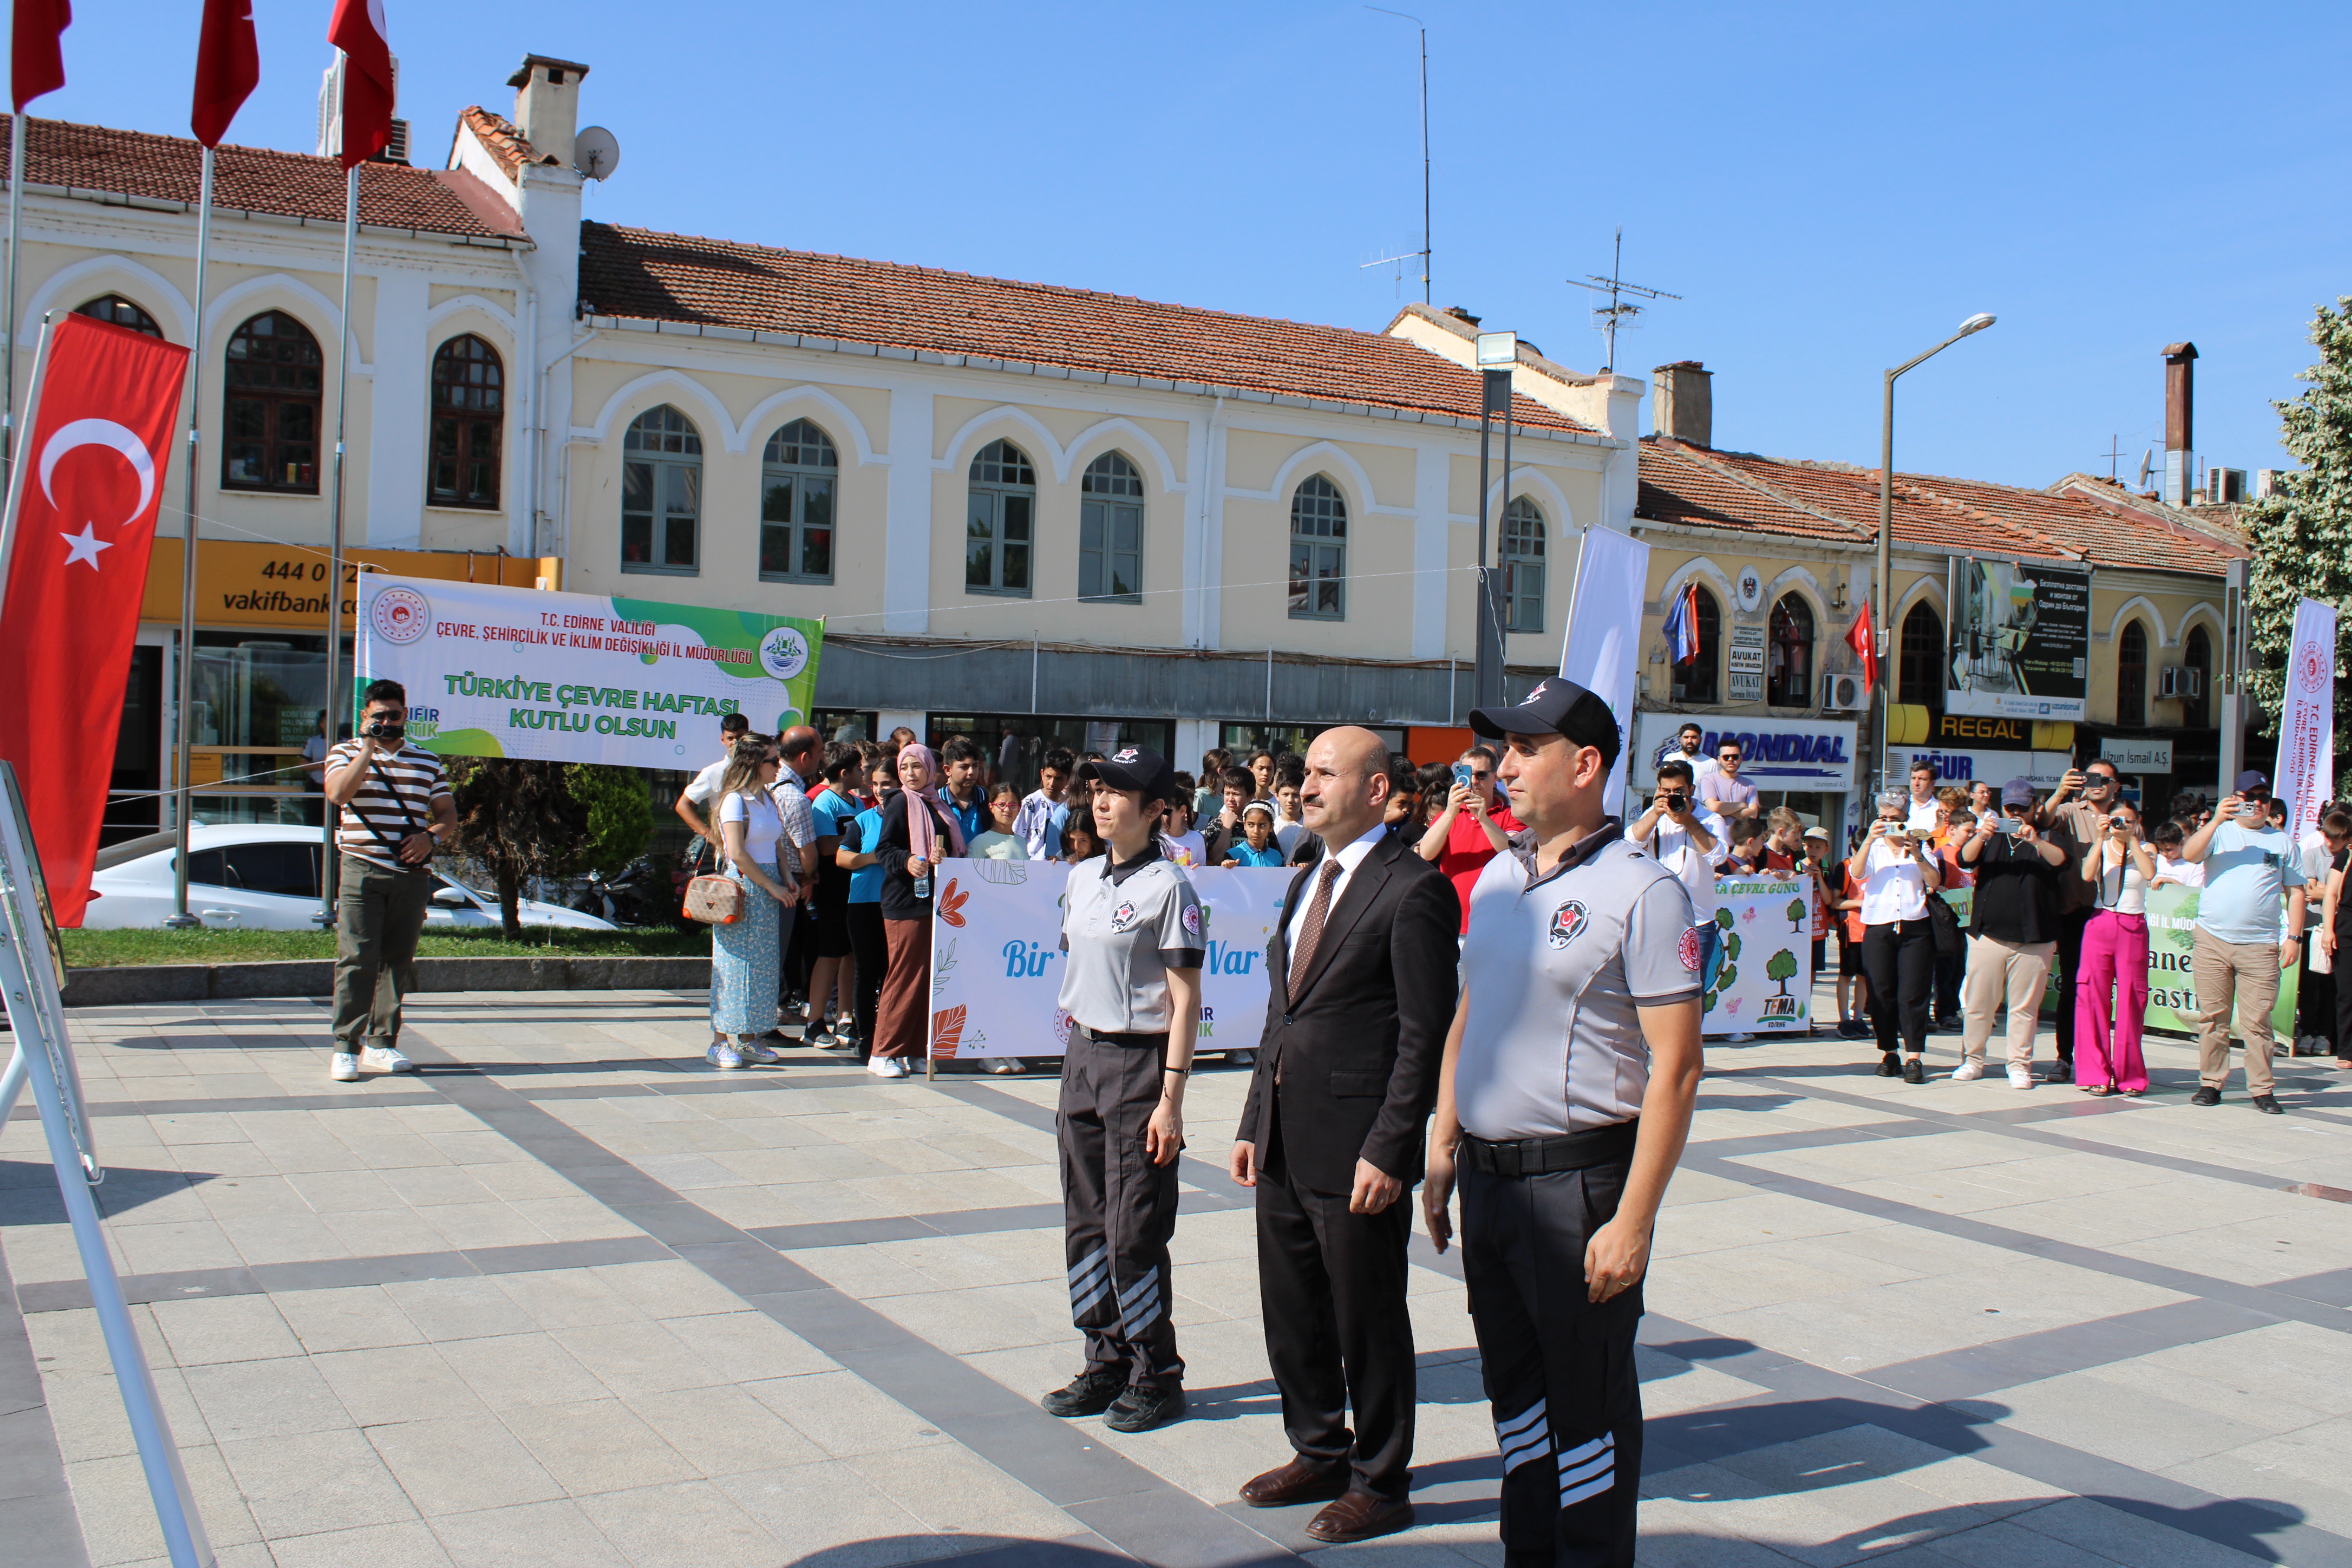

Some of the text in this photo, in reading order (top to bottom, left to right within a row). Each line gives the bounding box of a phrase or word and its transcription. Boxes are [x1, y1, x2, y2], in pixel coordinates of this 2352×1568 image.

[262, 561, 305, 580] 444
[311, 563, 326, 582] 0
[541, 612, 656, 636] T.C. EDİRNE VALİLİĞİ
[436, 621, 753, 665] ÇEVRE, ŞEHİRCİLİK VE İKLİM DEĞİŞİKLİĞİ İL MÜDÜRLÜĞÜ
[1732, 651, 1762, 661] AVUKAT
[1730, 675, 1760, 688] AVUKAT
[444, 670, 740, 718] TÜRKİYE ÇEVRE HAFTASI
[409, 707, 440, 722] IFIR
[509, 708, 677, 740] KUTLU OLSUN
[1941, 716, 2023, 740] REGAL
[1701, 731, 1849, 764] MONDIAL
[2103, 749, 2169, 767] Uzun İsmail A.Ş.
[2296, 736, 2306, 788] ŞEHİRCİLİK
[2305, 704, 2319, 822] T.C. EDİRNE VALİLİĞİ
[2295, 789, 2304, 802] VE
[2294, 803, 2304, 831] İKLİM
[1730, 883, 1767, 897] ÇEVRE
[2161, 913, 2170, 929] İL
[1002, 939, 1260, 978] Bir Var
[1763, 998, 1795, 1015] TEMA
